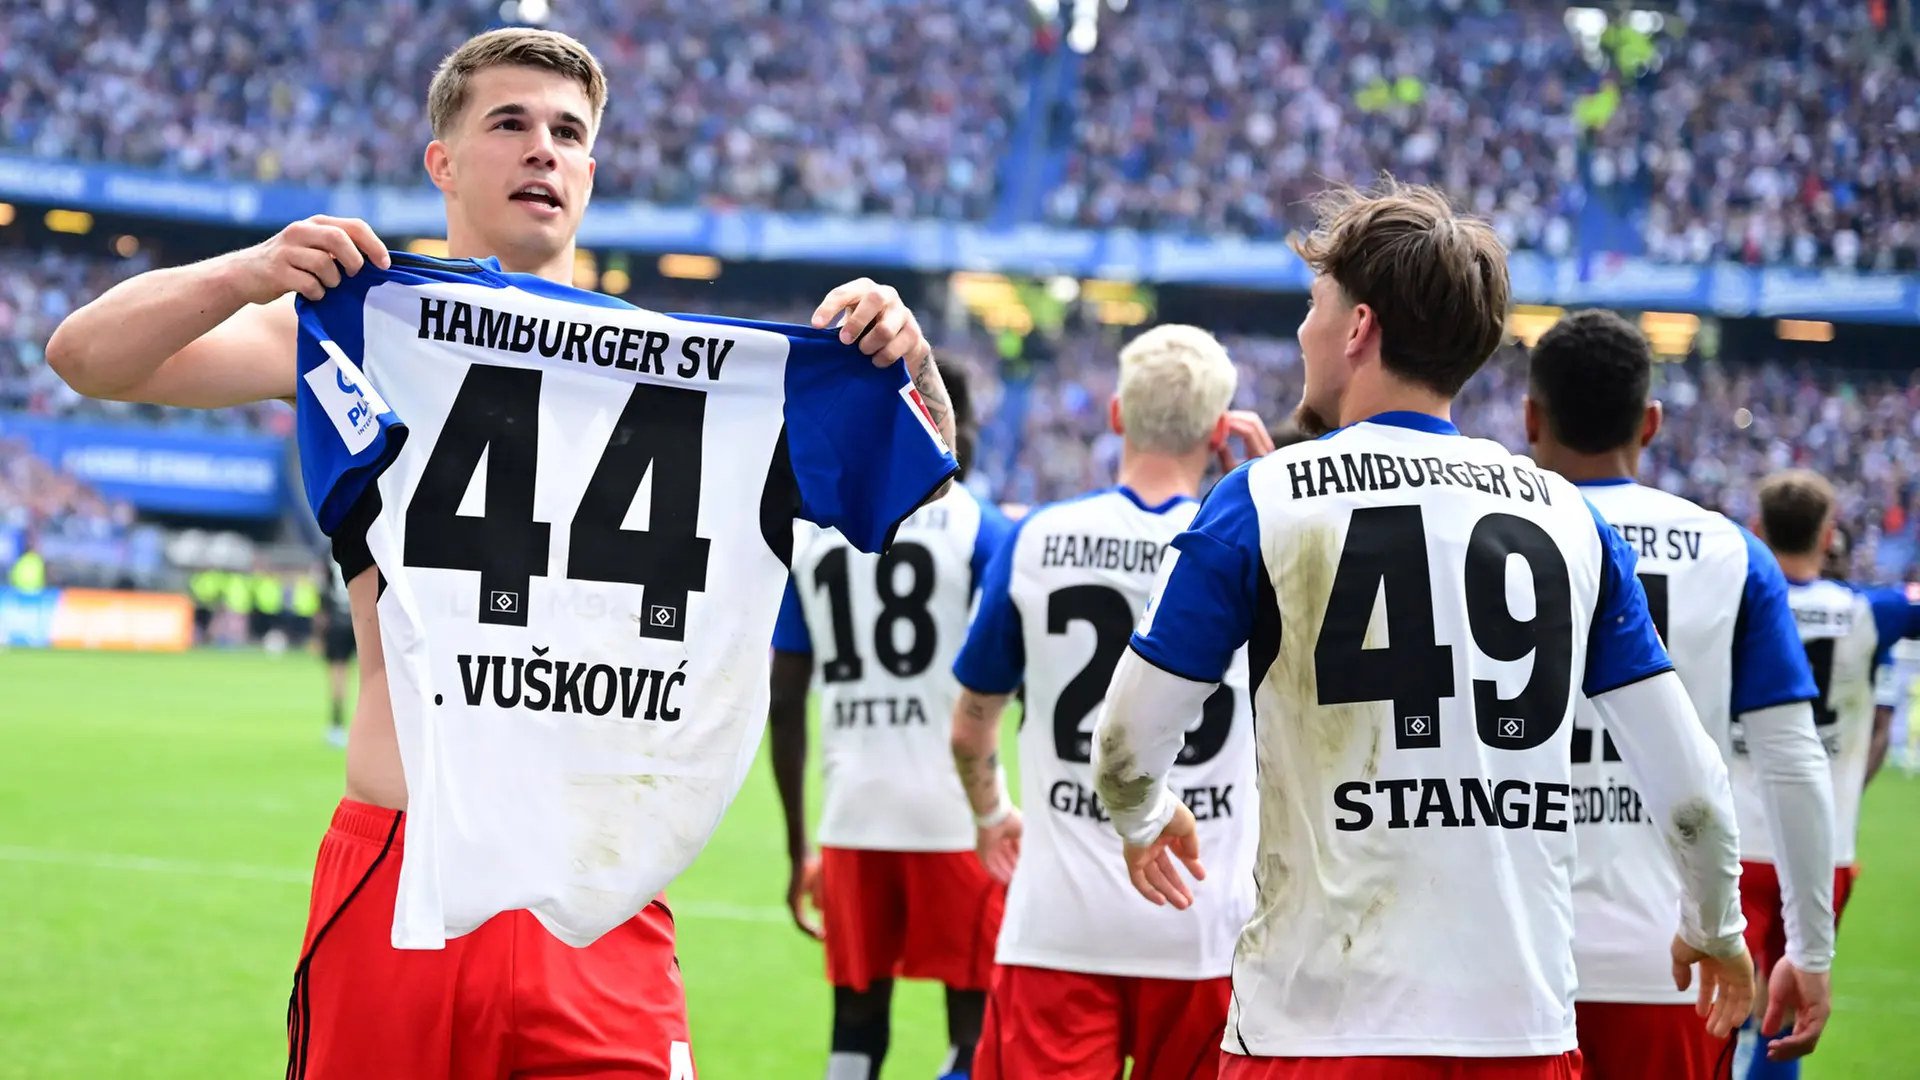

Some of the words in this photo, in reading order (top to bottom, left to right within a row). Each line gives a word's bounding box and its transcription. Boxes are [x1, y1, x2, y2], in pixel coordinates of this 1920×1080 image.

[417, 297, 670, 375] HAMBURGER
[676, 336, 735, 381] SV
[403, 363, 711, 642] 44
[1287, 453, 1511, 500] HAMBURGER
[1512, 466, 1553, 507] SV
[1667, 529, 1702, 561] SV
[813, 541, 937, 683] 18
[1313, 505, 1573, 751] 49
[457, 645, 689, 722] VUŠKOVIĆ
[1333, 777, 1570, 833] STANGE
